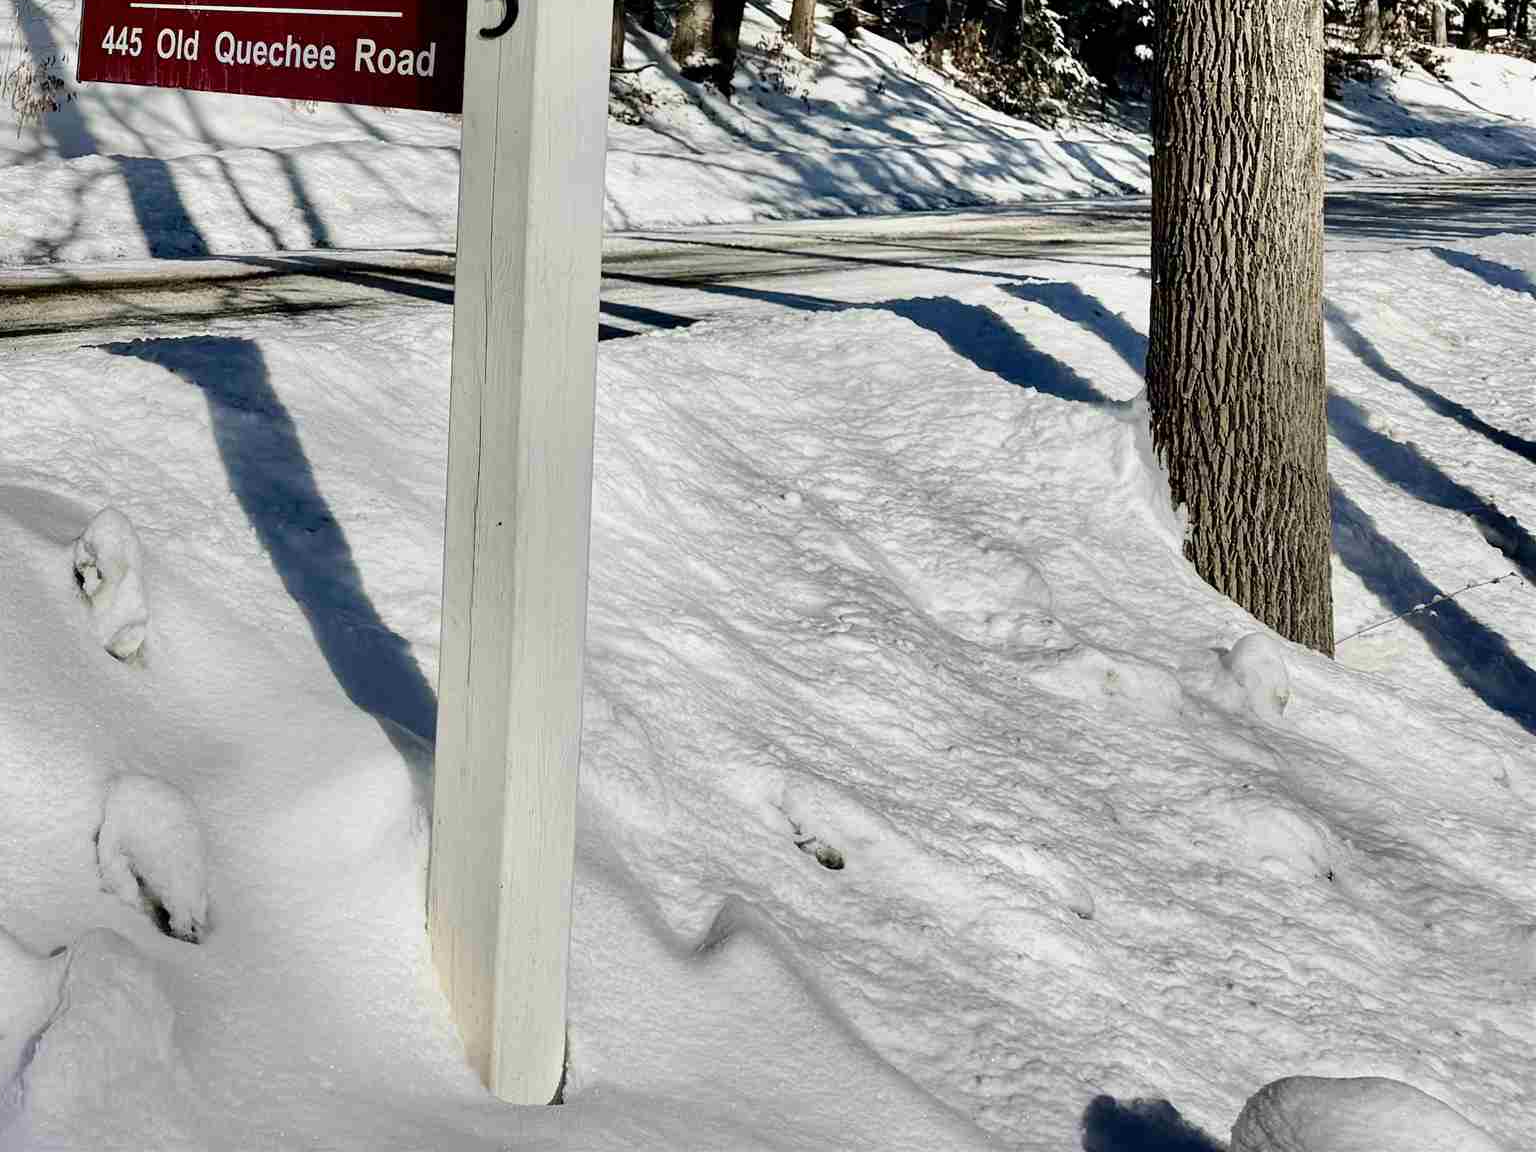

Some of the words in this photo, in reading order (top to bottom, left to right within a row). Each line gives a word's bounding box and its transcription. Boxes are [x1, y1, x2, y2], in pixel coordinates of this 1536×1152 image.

[101, 25, 143, 57] 445
[156, 28, 200, 61] Old
[214, 31, 336, 72] Quechee
[354, 38, 437, 77] Road
